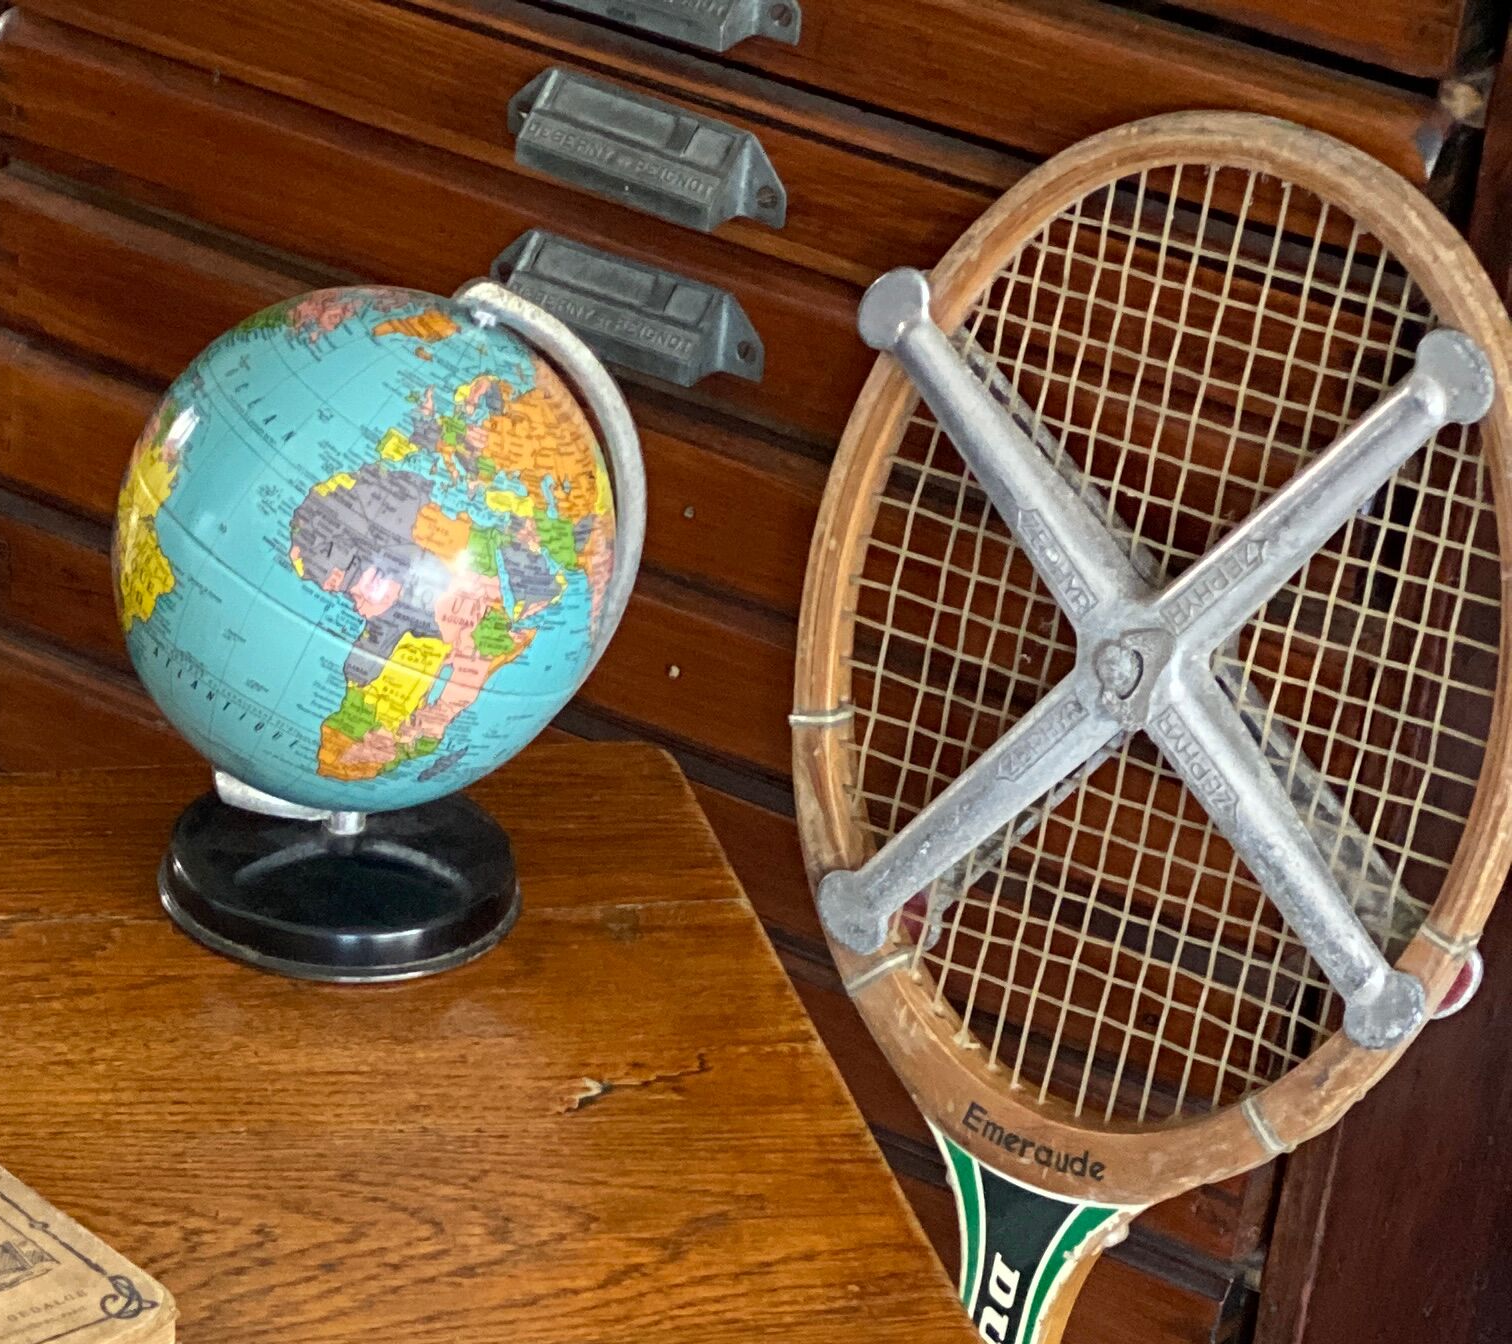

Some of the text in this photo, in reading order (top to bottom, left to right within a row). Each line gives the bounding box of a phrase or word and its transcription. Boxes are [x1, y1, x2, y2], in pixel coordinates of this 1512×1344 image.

[1020, 512, 1094, 616] ZEPHYR
[1164, 545, 1262, 633] ZEPHYR
[1003, 699, 1088, 777] ZEPHYR
[1157, 711, 1236, 810] ZEPHYR
[961, 1101, 1108, 1184] Emeraude
